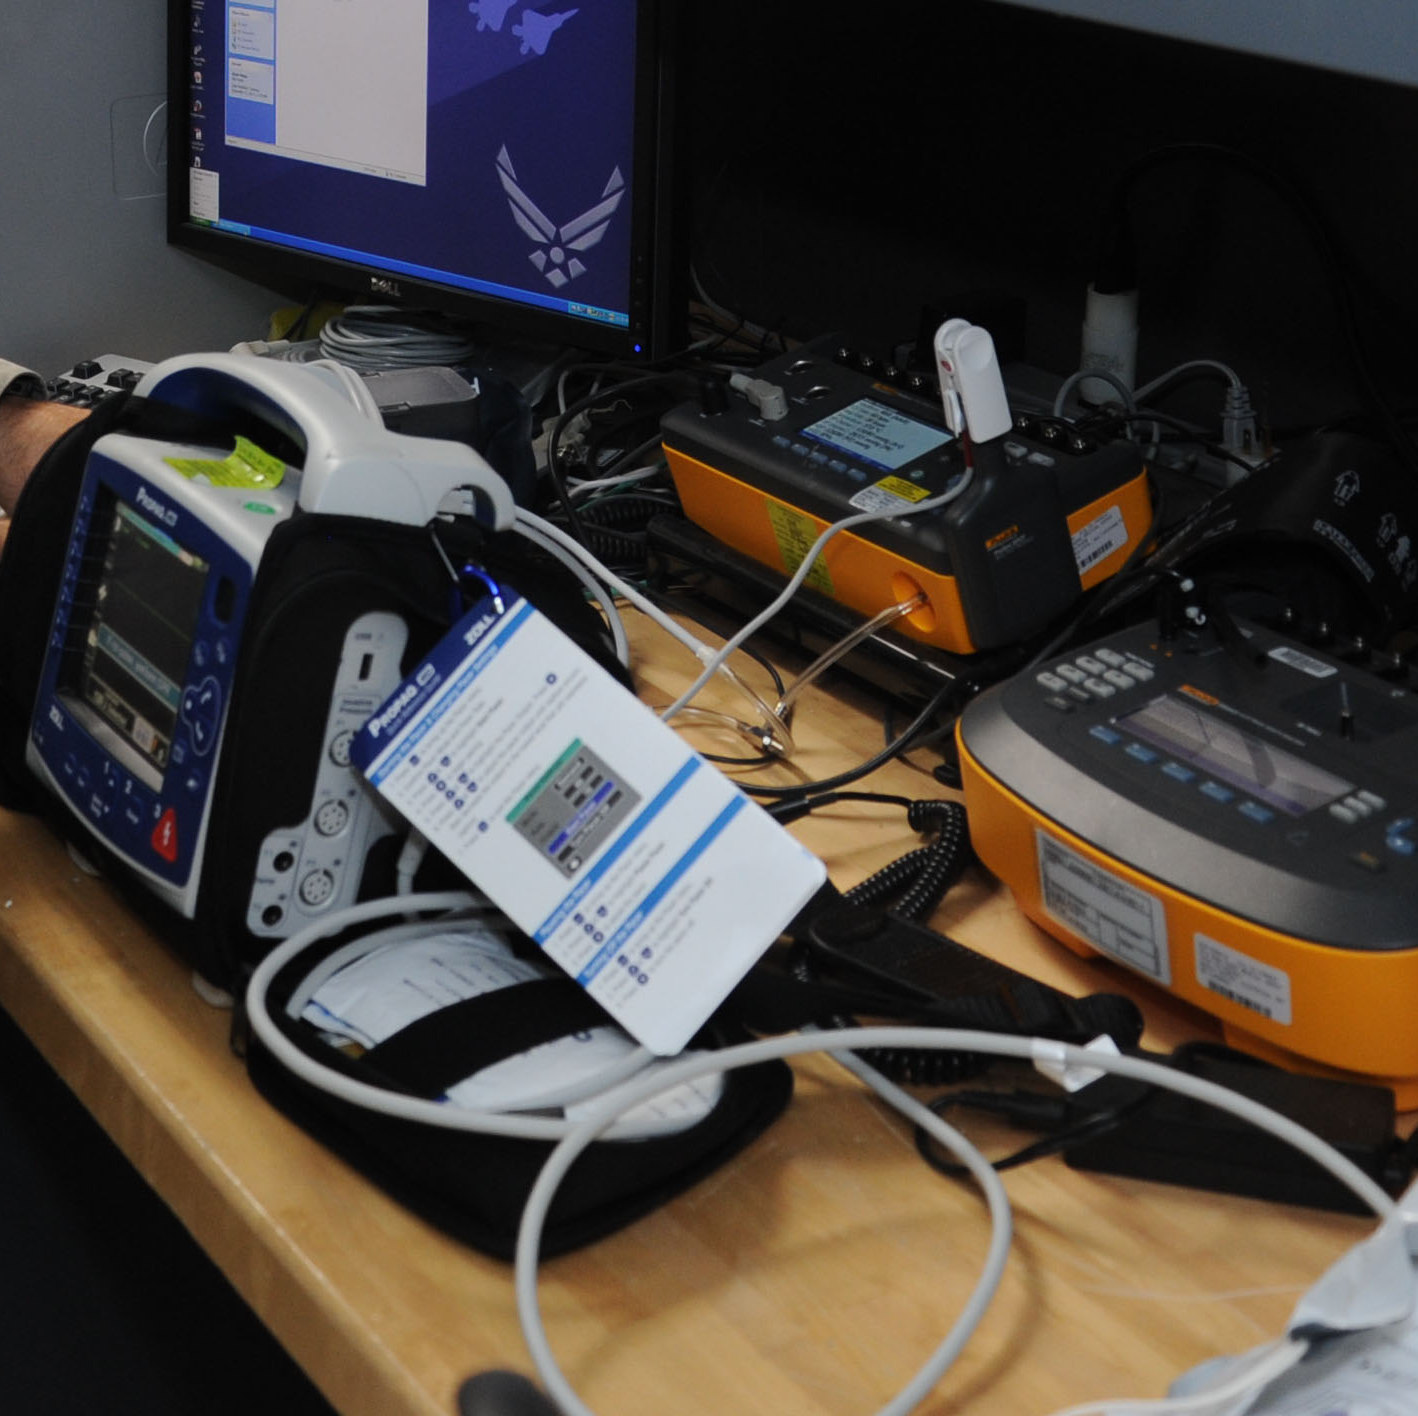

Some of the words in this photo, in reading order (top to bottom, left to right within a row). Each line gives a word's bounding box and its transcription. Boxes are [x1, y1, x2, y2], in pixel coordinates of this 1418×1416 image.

[371, 277, 401, 296] DELL
[463, 614, 496, 645] ZOLL
[368, 684, 418, 738] PROPAQ
